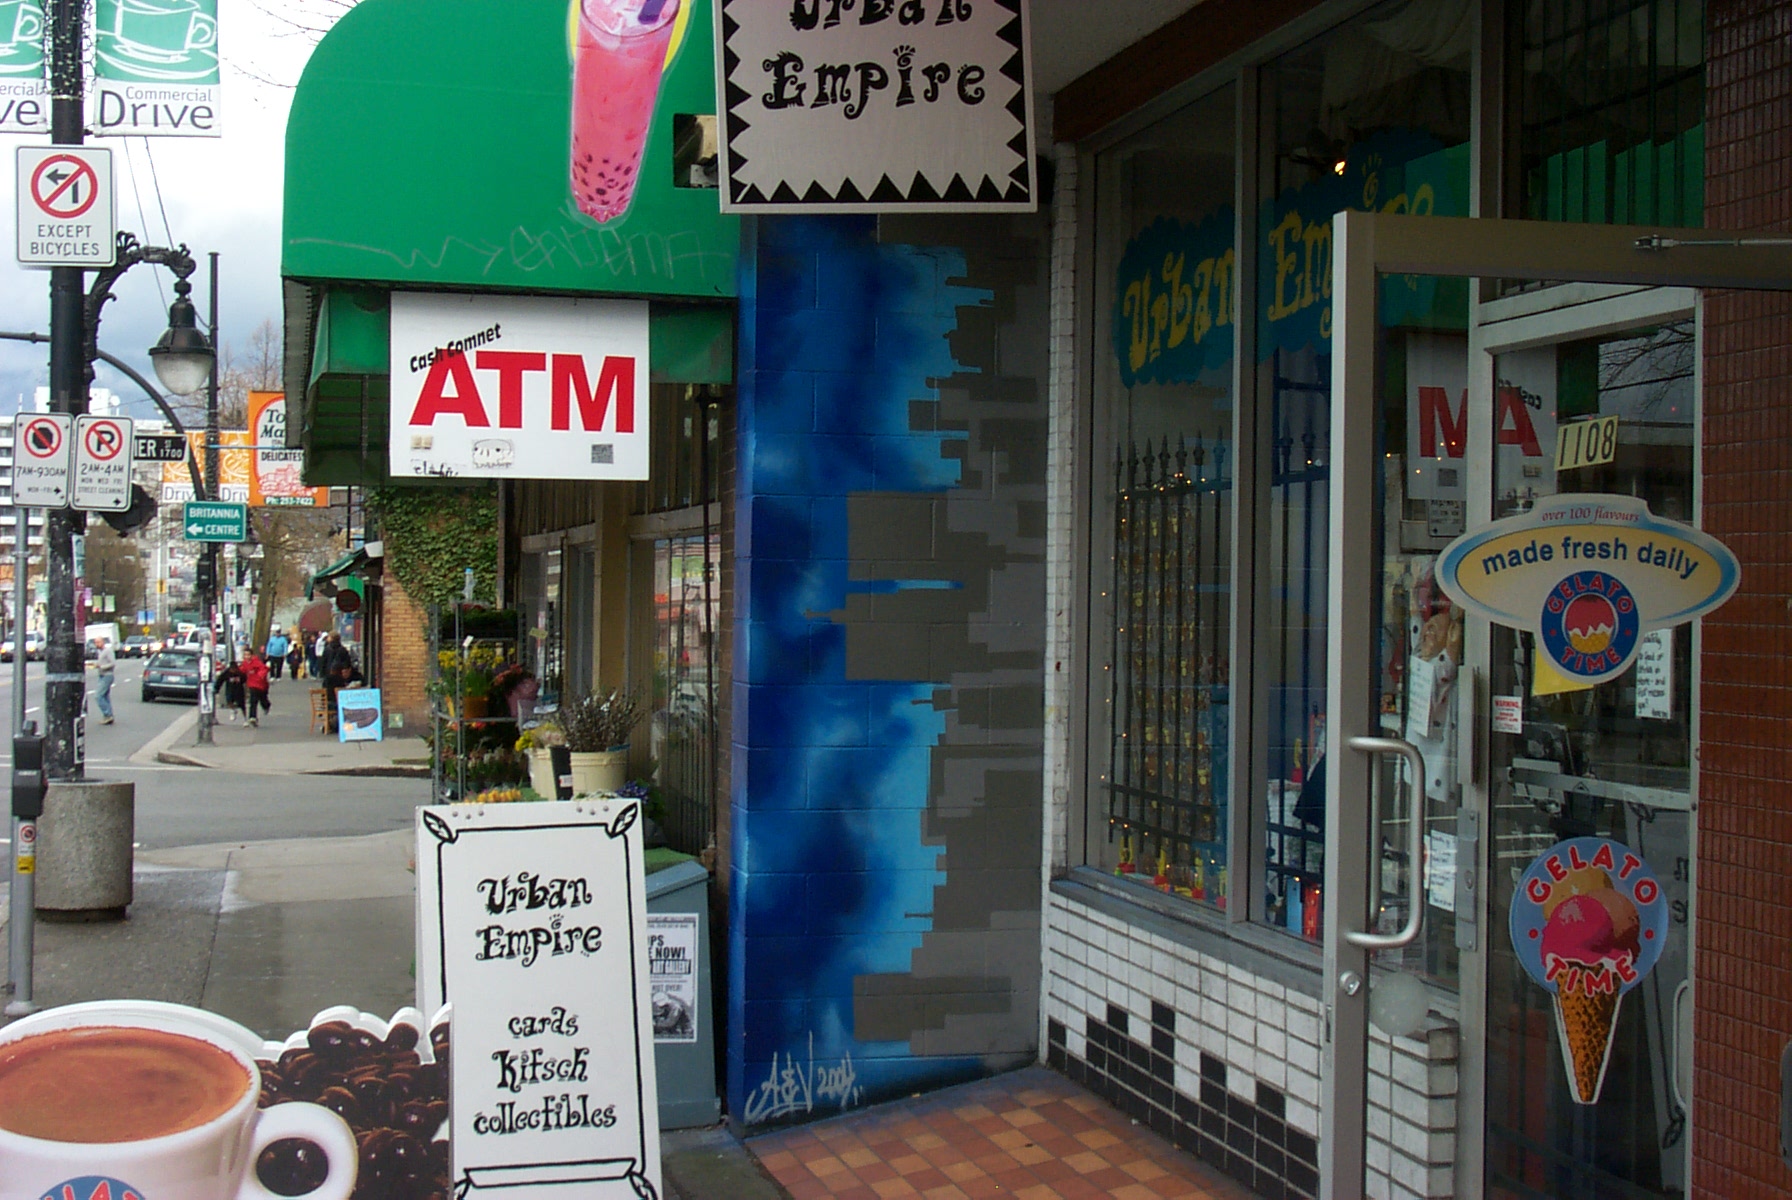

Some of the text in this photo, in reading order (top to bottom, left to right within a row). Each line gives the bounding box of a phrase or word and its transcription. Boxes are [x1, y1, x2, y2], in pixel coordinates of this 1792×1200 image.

[125, 86, 212, 103] Commercial
[761, 44, 986, 120] Empire
[99, 90, 214, 130] Drive
[30, 241, 100, 258] BICYCLES
[37, 224, 92, 239] EXCEPT
[408, 348, 636, 434] ATM
[160, 448, 183, 459] 1700
[1560, 419, 1615, 466] 1108
[165, 486, 197, 501] Driv
[189, 507, 241, 519] BRITANNIA
[204, 524, 240, 536] CENTRE
[1541, 506, 1639, 523] over 100 flavours
[1482, 536, 1700, 580] made fresh daily
[1547, 573, 1634, 615] GELATO
[1560, 646, 1622, 674] TIME
[1526, 843, 1659, 905] GELATO
[476, 871, 592, 915] Urban
[475, 914, 602, 968] Empire
[648, 934, 665, 947] PS
[655, 946, 686, 960] NOW!
[1544, 957, 1637, 998] TIME
[508, 1007, 580, 1039] cards
[491, 1047, 590, 1093] Kitsch
[473, 1094, 617, 1135] collectibles
